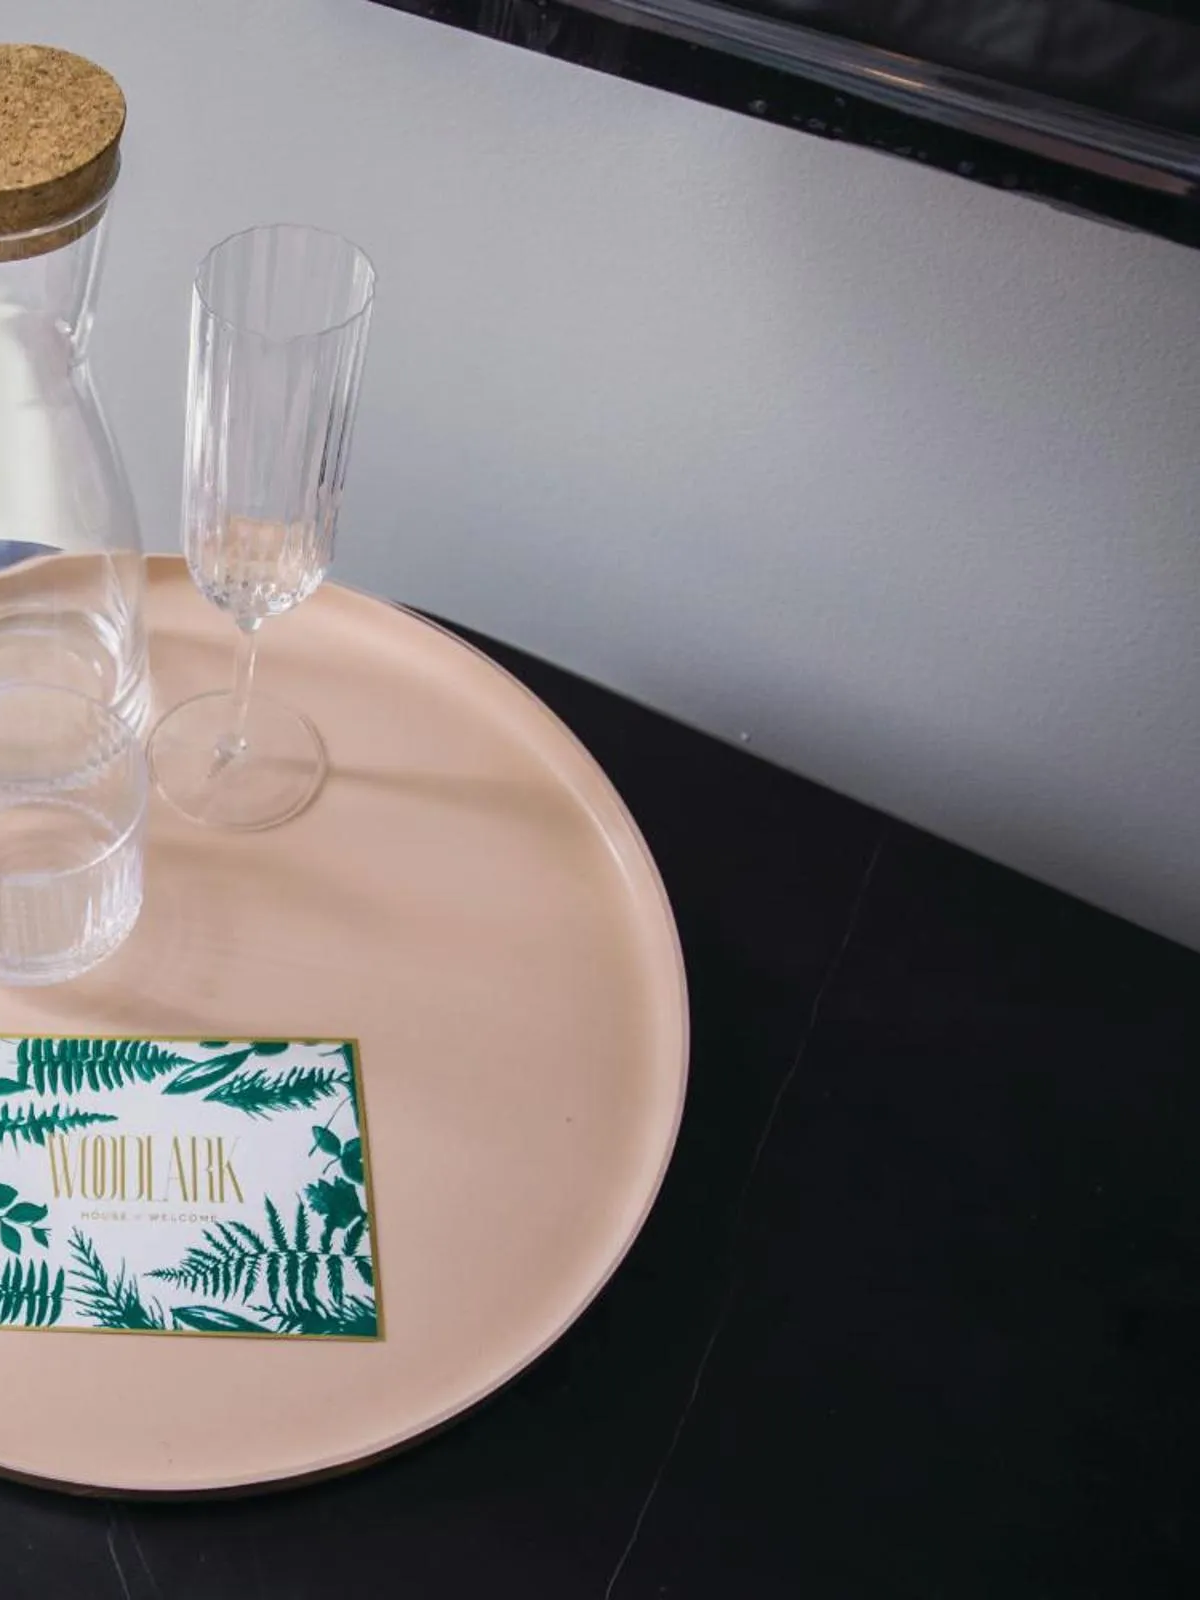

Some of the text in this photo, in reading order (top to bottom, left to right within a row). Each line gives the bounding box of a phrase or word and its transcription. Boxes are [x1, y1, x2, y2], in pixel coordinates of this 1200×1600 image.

[48, 1133, 244, 1204] WOODLARK
[81, 1210, 127, 1221] HOUSE
[148, 1212, 217, 1223] WELCOME
